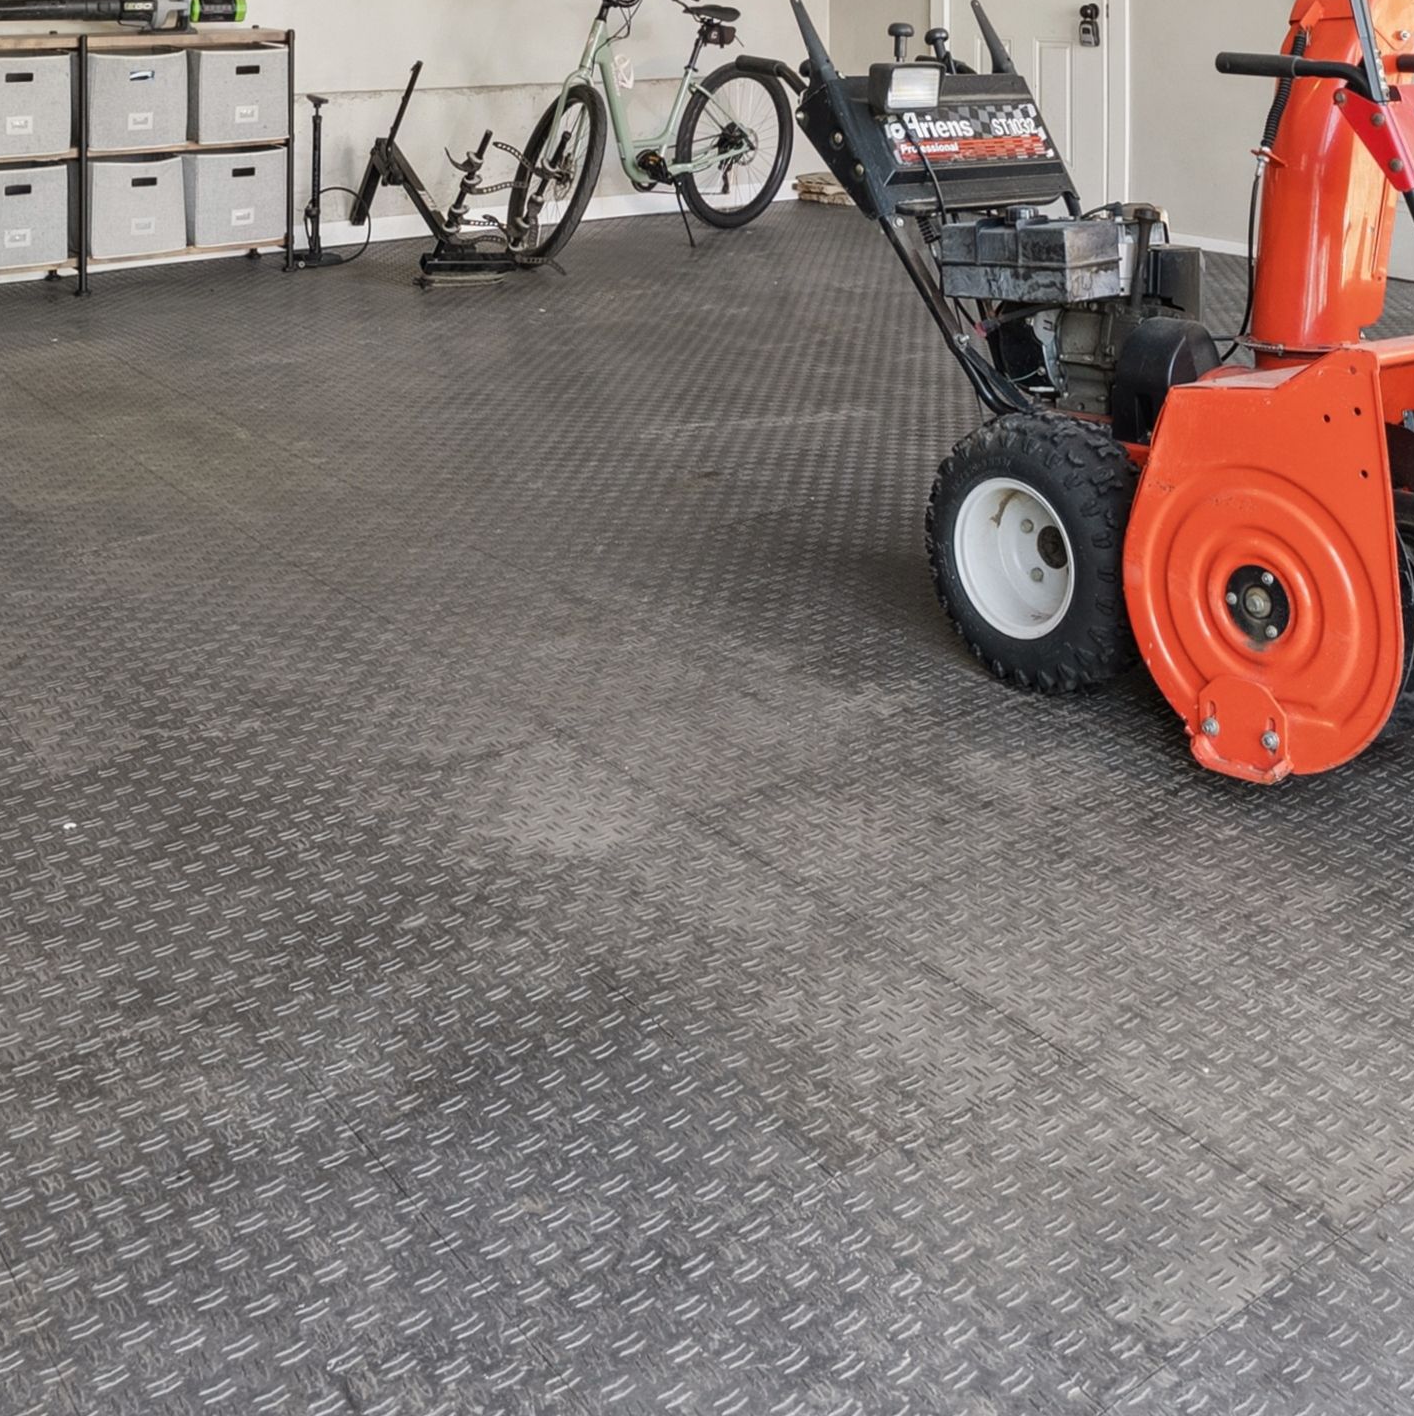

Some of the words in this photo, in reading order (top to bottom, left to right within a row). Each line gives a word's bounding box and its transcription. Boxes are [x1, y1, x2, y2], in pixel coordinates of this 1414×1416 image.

[903, 112, 975, 138] Ariens
[991, 117, 1038, 135] ST1032
[900, 141, 959, 154] Proessional
